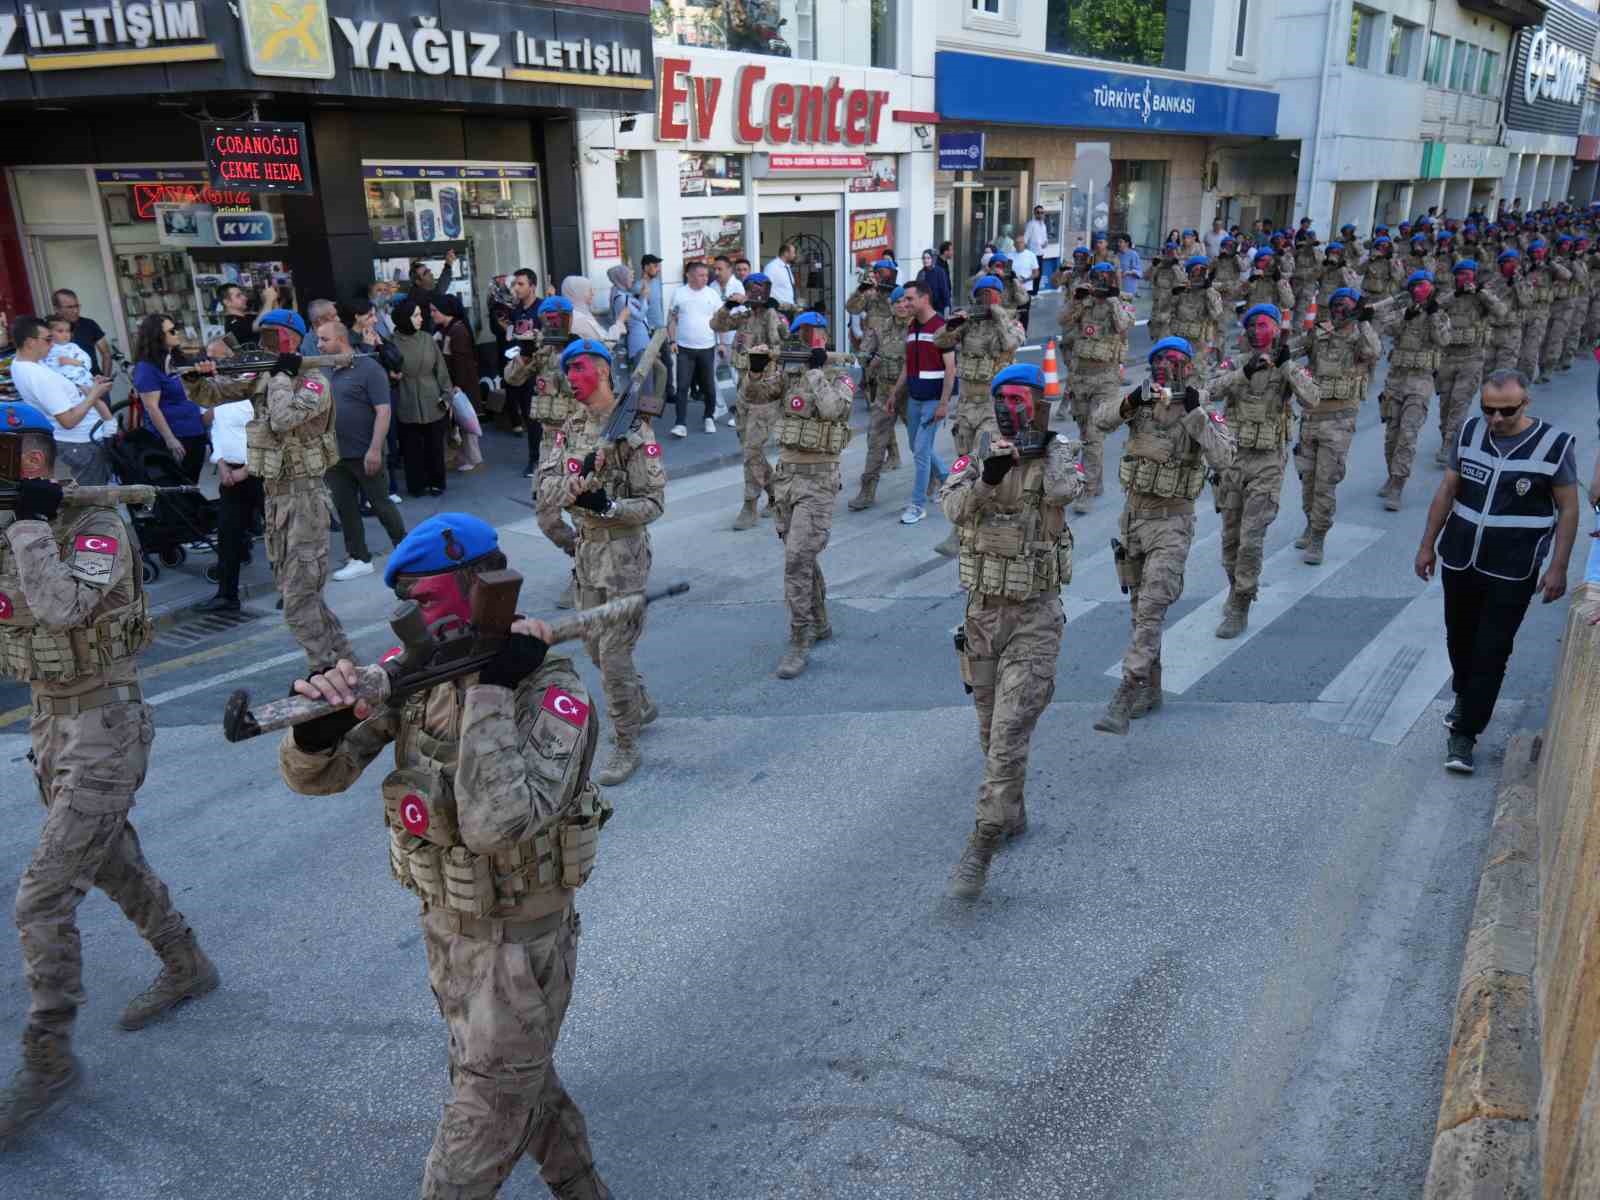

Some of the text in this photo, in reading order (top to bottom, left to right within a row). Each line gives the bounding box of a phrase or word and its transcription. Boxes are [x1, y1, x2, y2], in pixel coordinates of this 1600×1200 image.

[24, 0, 199, 48] İLETİŞİM
[333, 15, 642, 79] YAĞIZ İLETİŞİM
[657, 57, 890, 146] Ev Center
[1093, 85, 1141, 111] TÜRKİYE
[1152, 94, 1196, 115] BANKASI
[215, 134, 299, 156] ÇOBANOĞLU
[219, 160, 304, 182] ÇEKME HELVA
[222, 221, 266, 236] KVK
[855, 217, 889, 241] DEV
